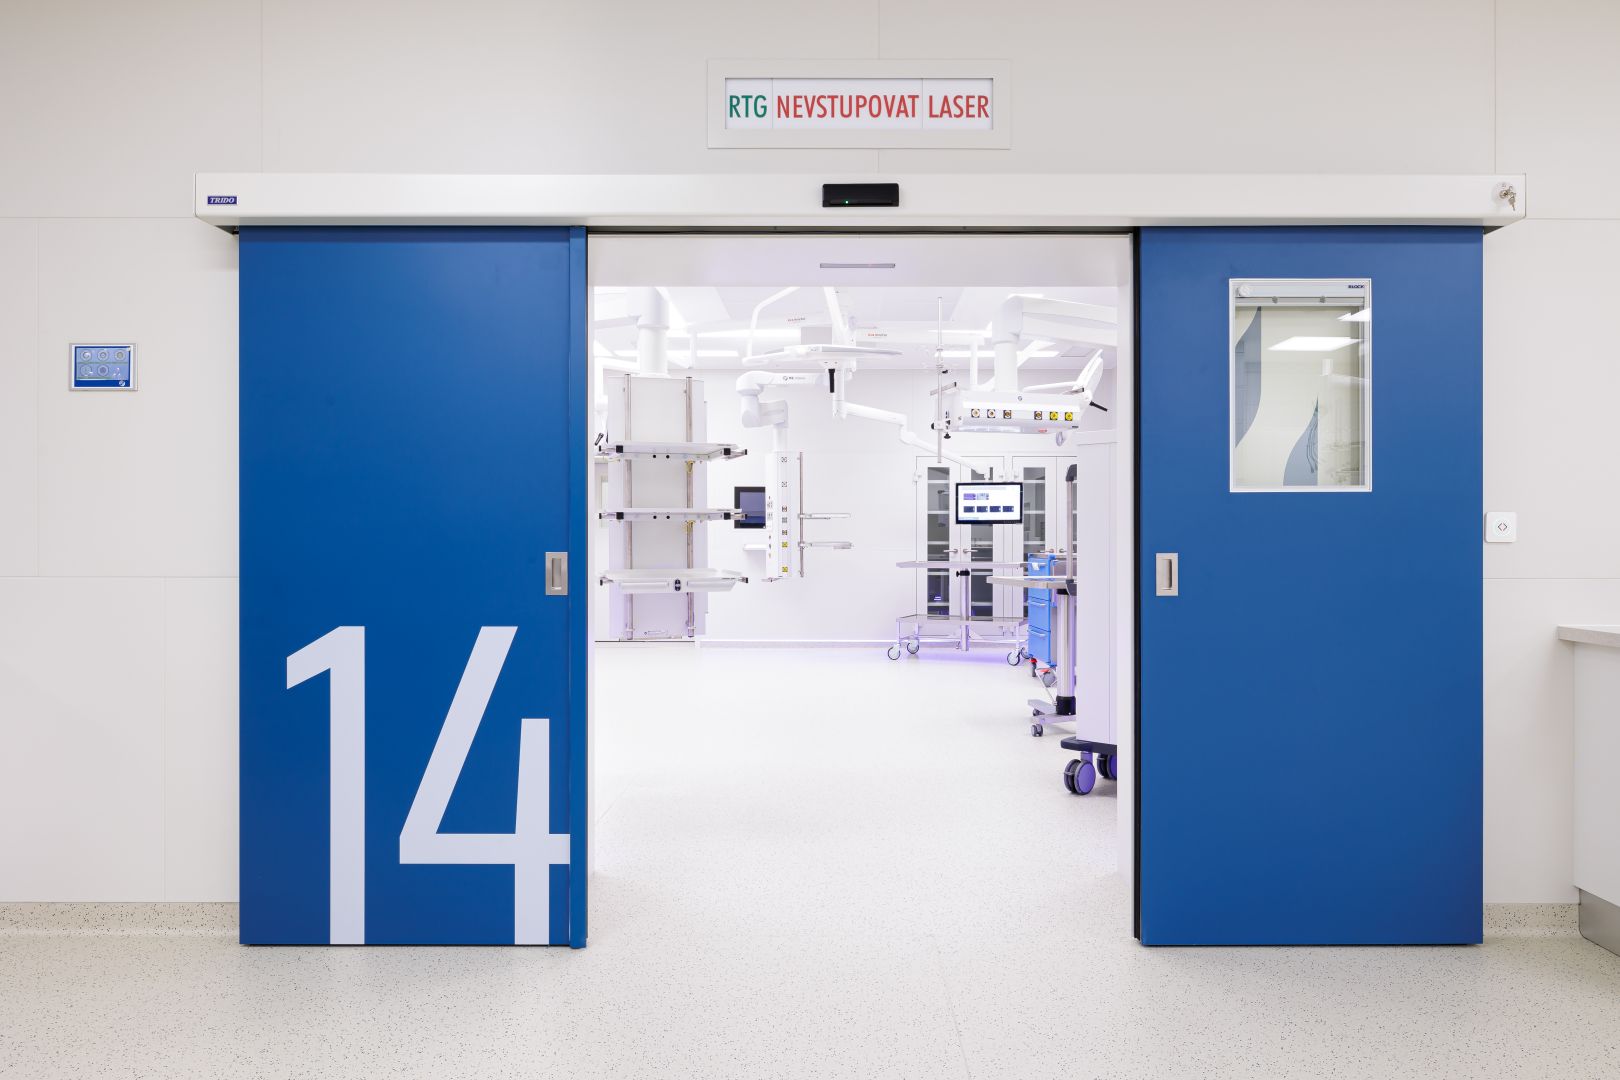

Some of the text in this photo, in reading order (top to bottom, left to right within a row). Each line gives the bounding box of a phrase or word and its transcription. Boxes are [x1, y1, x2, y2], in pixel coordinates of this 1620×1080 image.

[729, 95, 990, 118] RTG NEVSTUPOVAT LASER
[286, 626, 571, 945] 14
